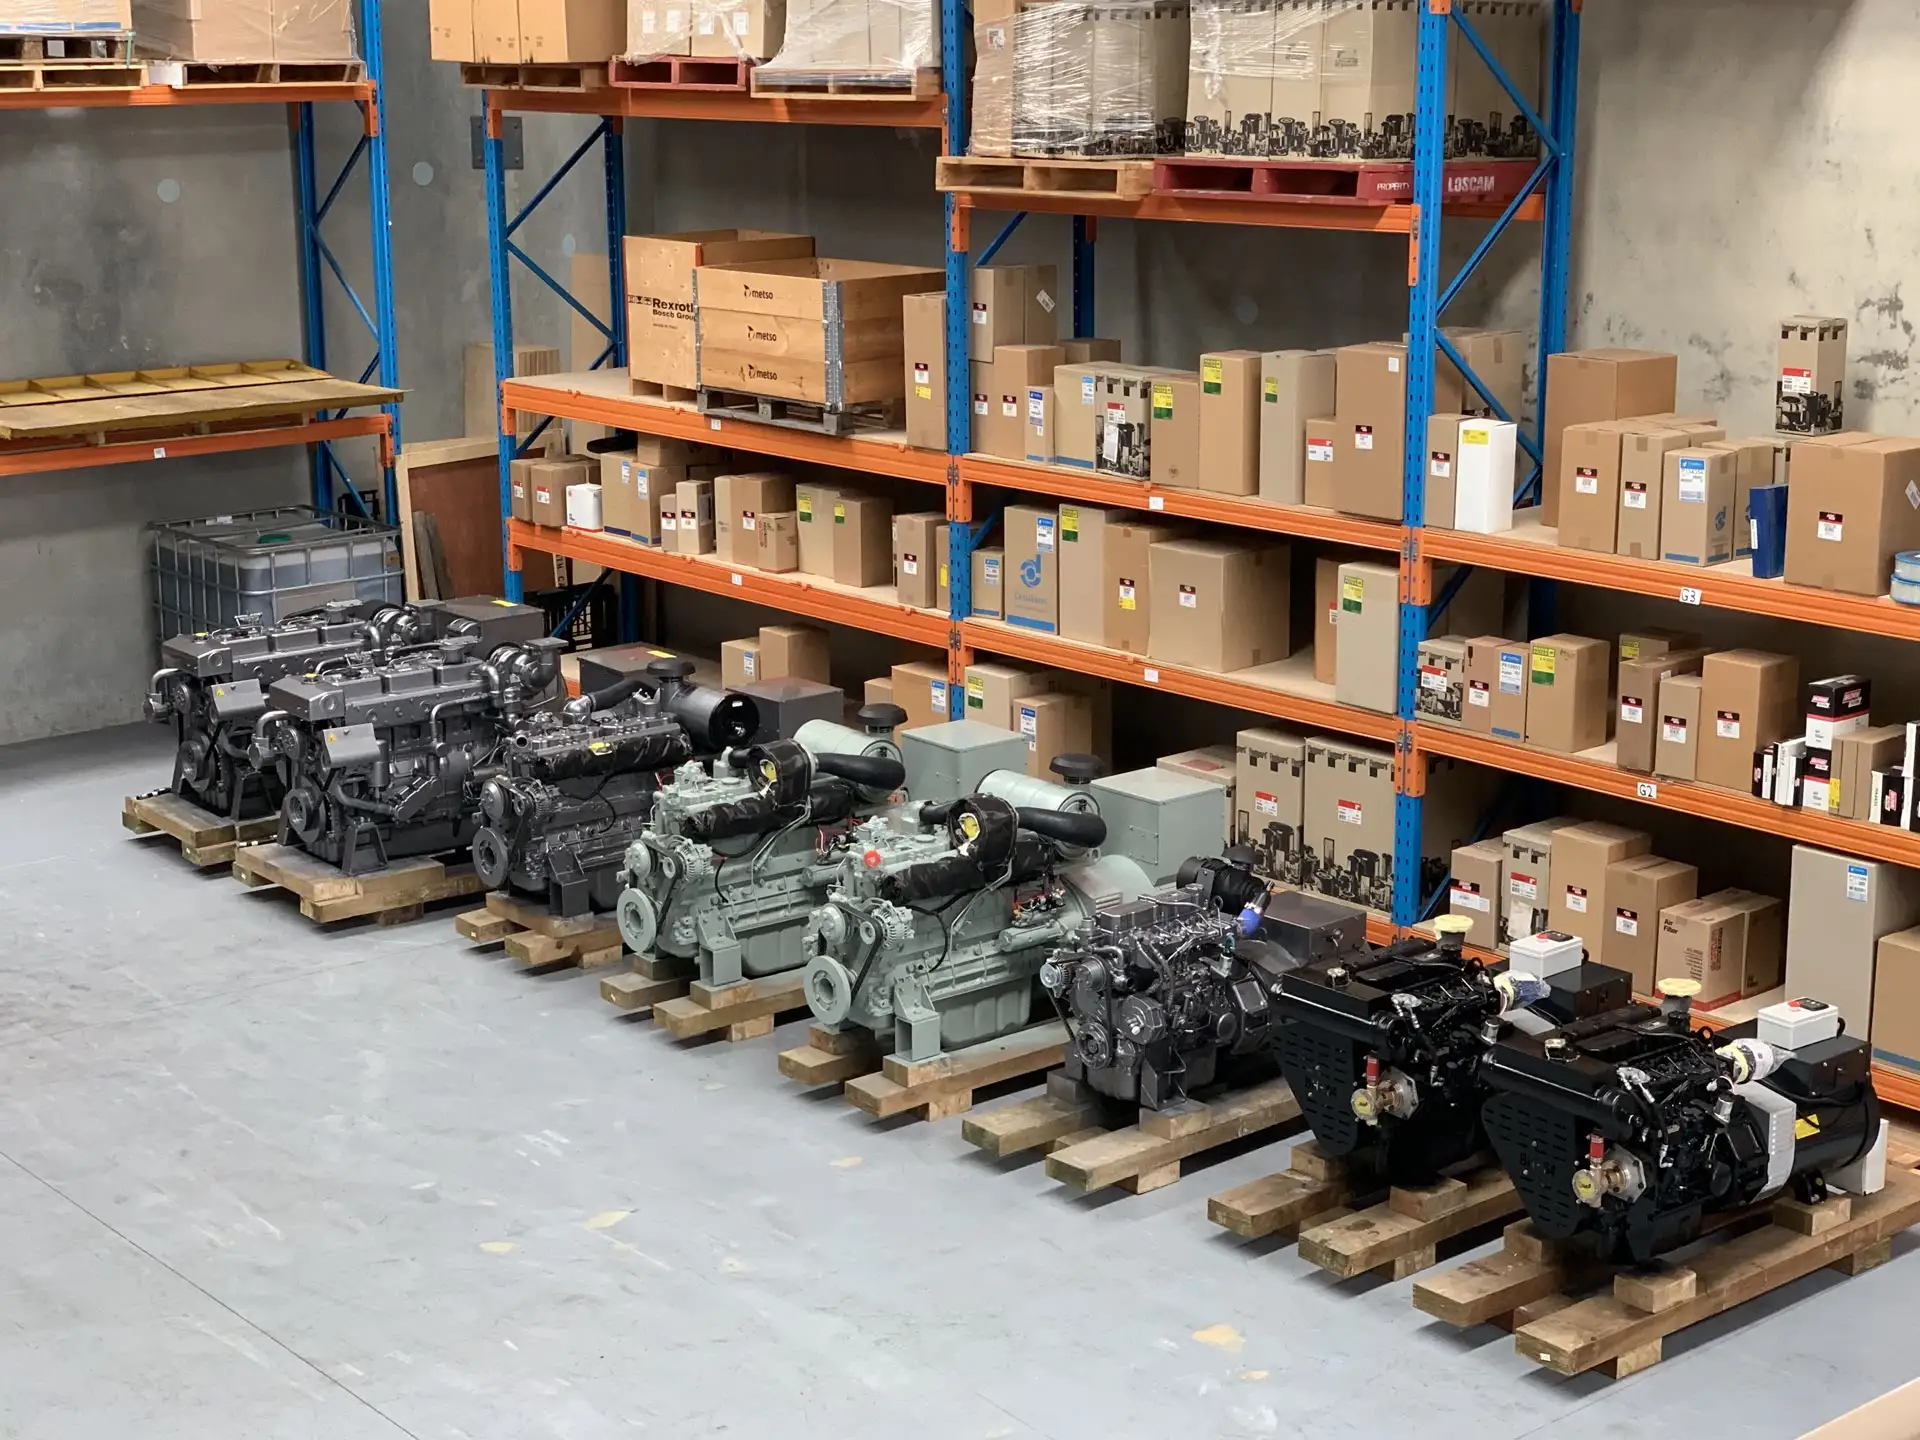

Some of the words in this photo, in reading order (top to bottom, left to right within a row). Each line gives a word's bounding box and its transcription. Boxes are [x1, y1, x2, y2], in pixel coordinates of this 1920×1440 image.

[1447, 176, 1495, 192] LOSCAM
[751, 289, 774, 300] metso
[652, 308, 675, 318] Bosch
[755, 331, 777, 342] metso
[756, 369, 778, 381] metso
[1682, 588, 1696, 603] G3
[1639, 784, 1653, 798] G2
[1663, 918, 1674, 926] Air
[1663, 924, 1679, 935] Filter
